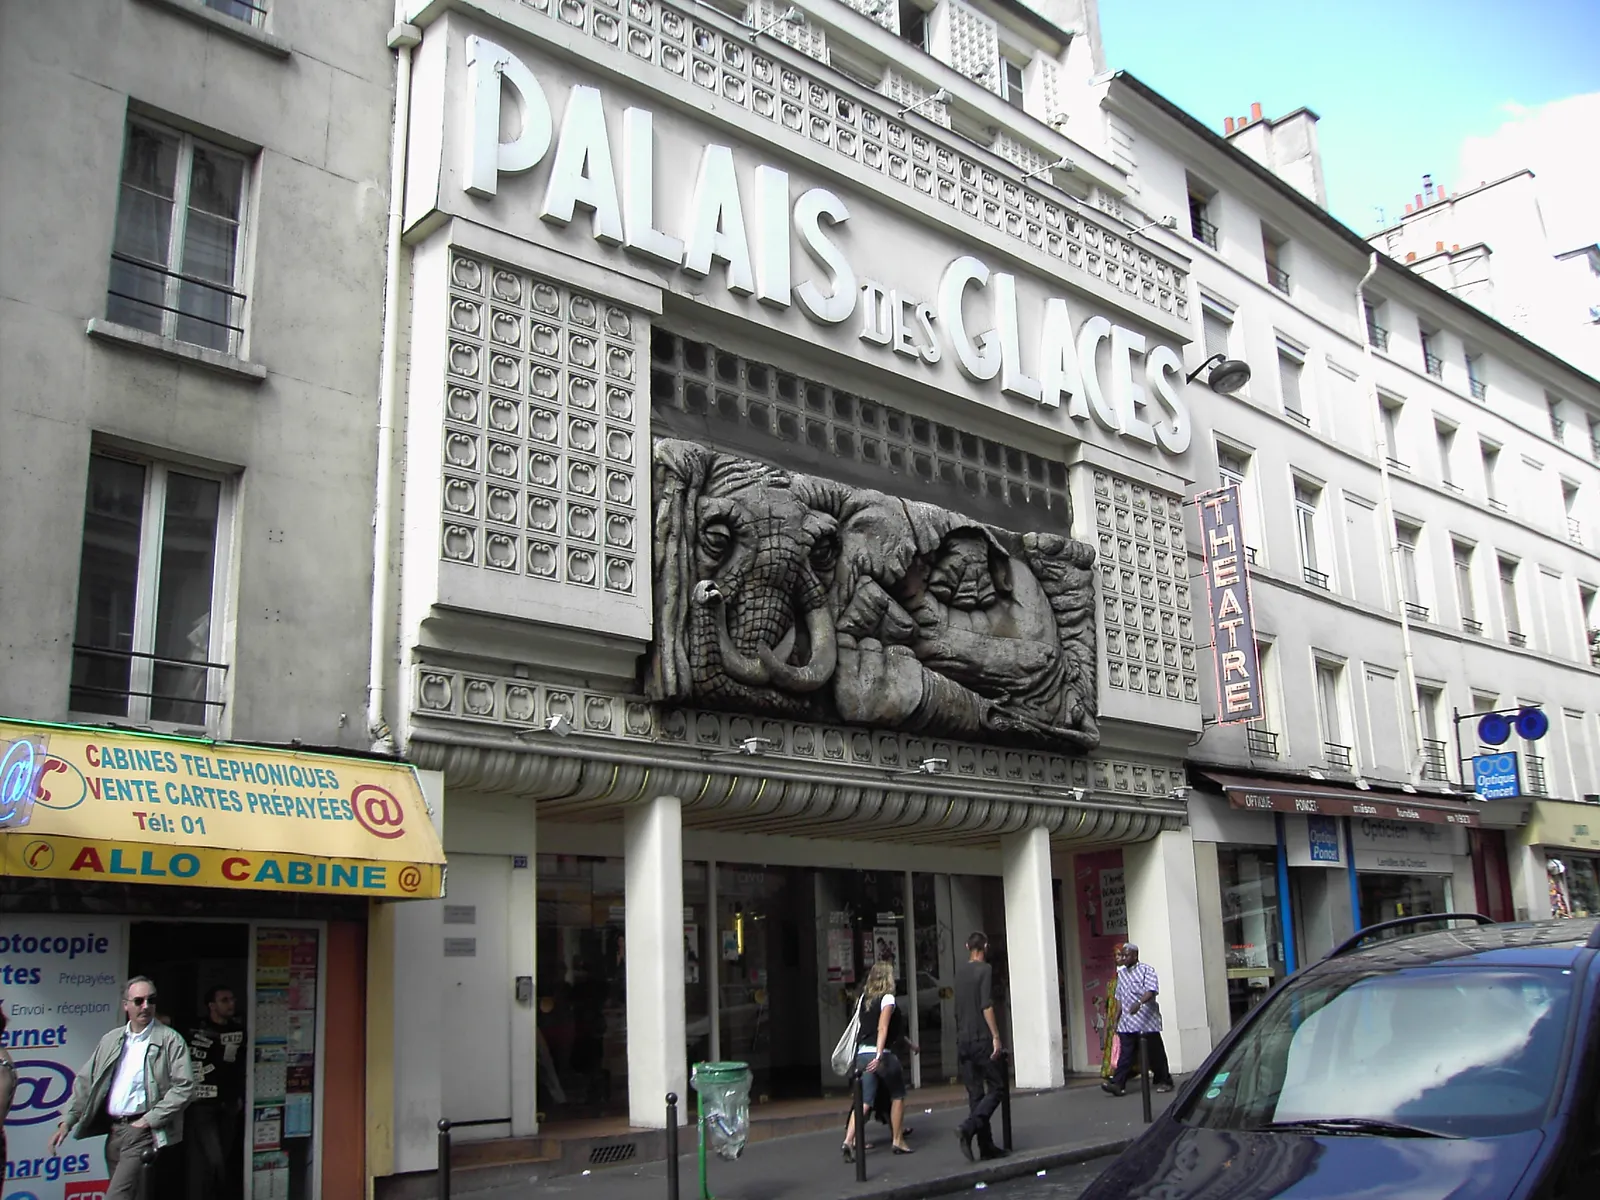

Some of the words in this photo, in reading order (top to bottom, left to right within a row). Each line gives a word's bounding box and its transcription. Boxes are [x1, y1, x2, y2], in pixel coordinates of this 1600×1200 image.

[463, 34, 859, 325] PALAIS
[859, 277, 942, 365] DES
[938, 255, 1192, 456] GLACES
[1204, 494, 1254, 715] THEATRE
[85, 744, 178, 774] CABINES
[180, 753, 339, 790] TELEPHONIQUES
[1477, 773, 1516, 789] Optique
[1481, 786, 1514, 798] Poncet
[85, 776, 161, 804] VENTE
[164, 782, 243, 813] CARTES
[246, 788, 354, 822] PRÉPAYÉES
[1353, 803, 1377, 814] maison
[132, 812, 175, 834] Tél:
[181, 815, 207, 836] 01
[1313, 845, 1338, 860] Poncet
[69, 847, 201, 878] ALLO
[221, 857, 387, 889] CABINE
[0, 964, 42, 985] tes
[58, 972, 117, 988] Prépayées
[11, 1003, 45, 1016] Envoi
[56, 1001, 111, 1017] réception
